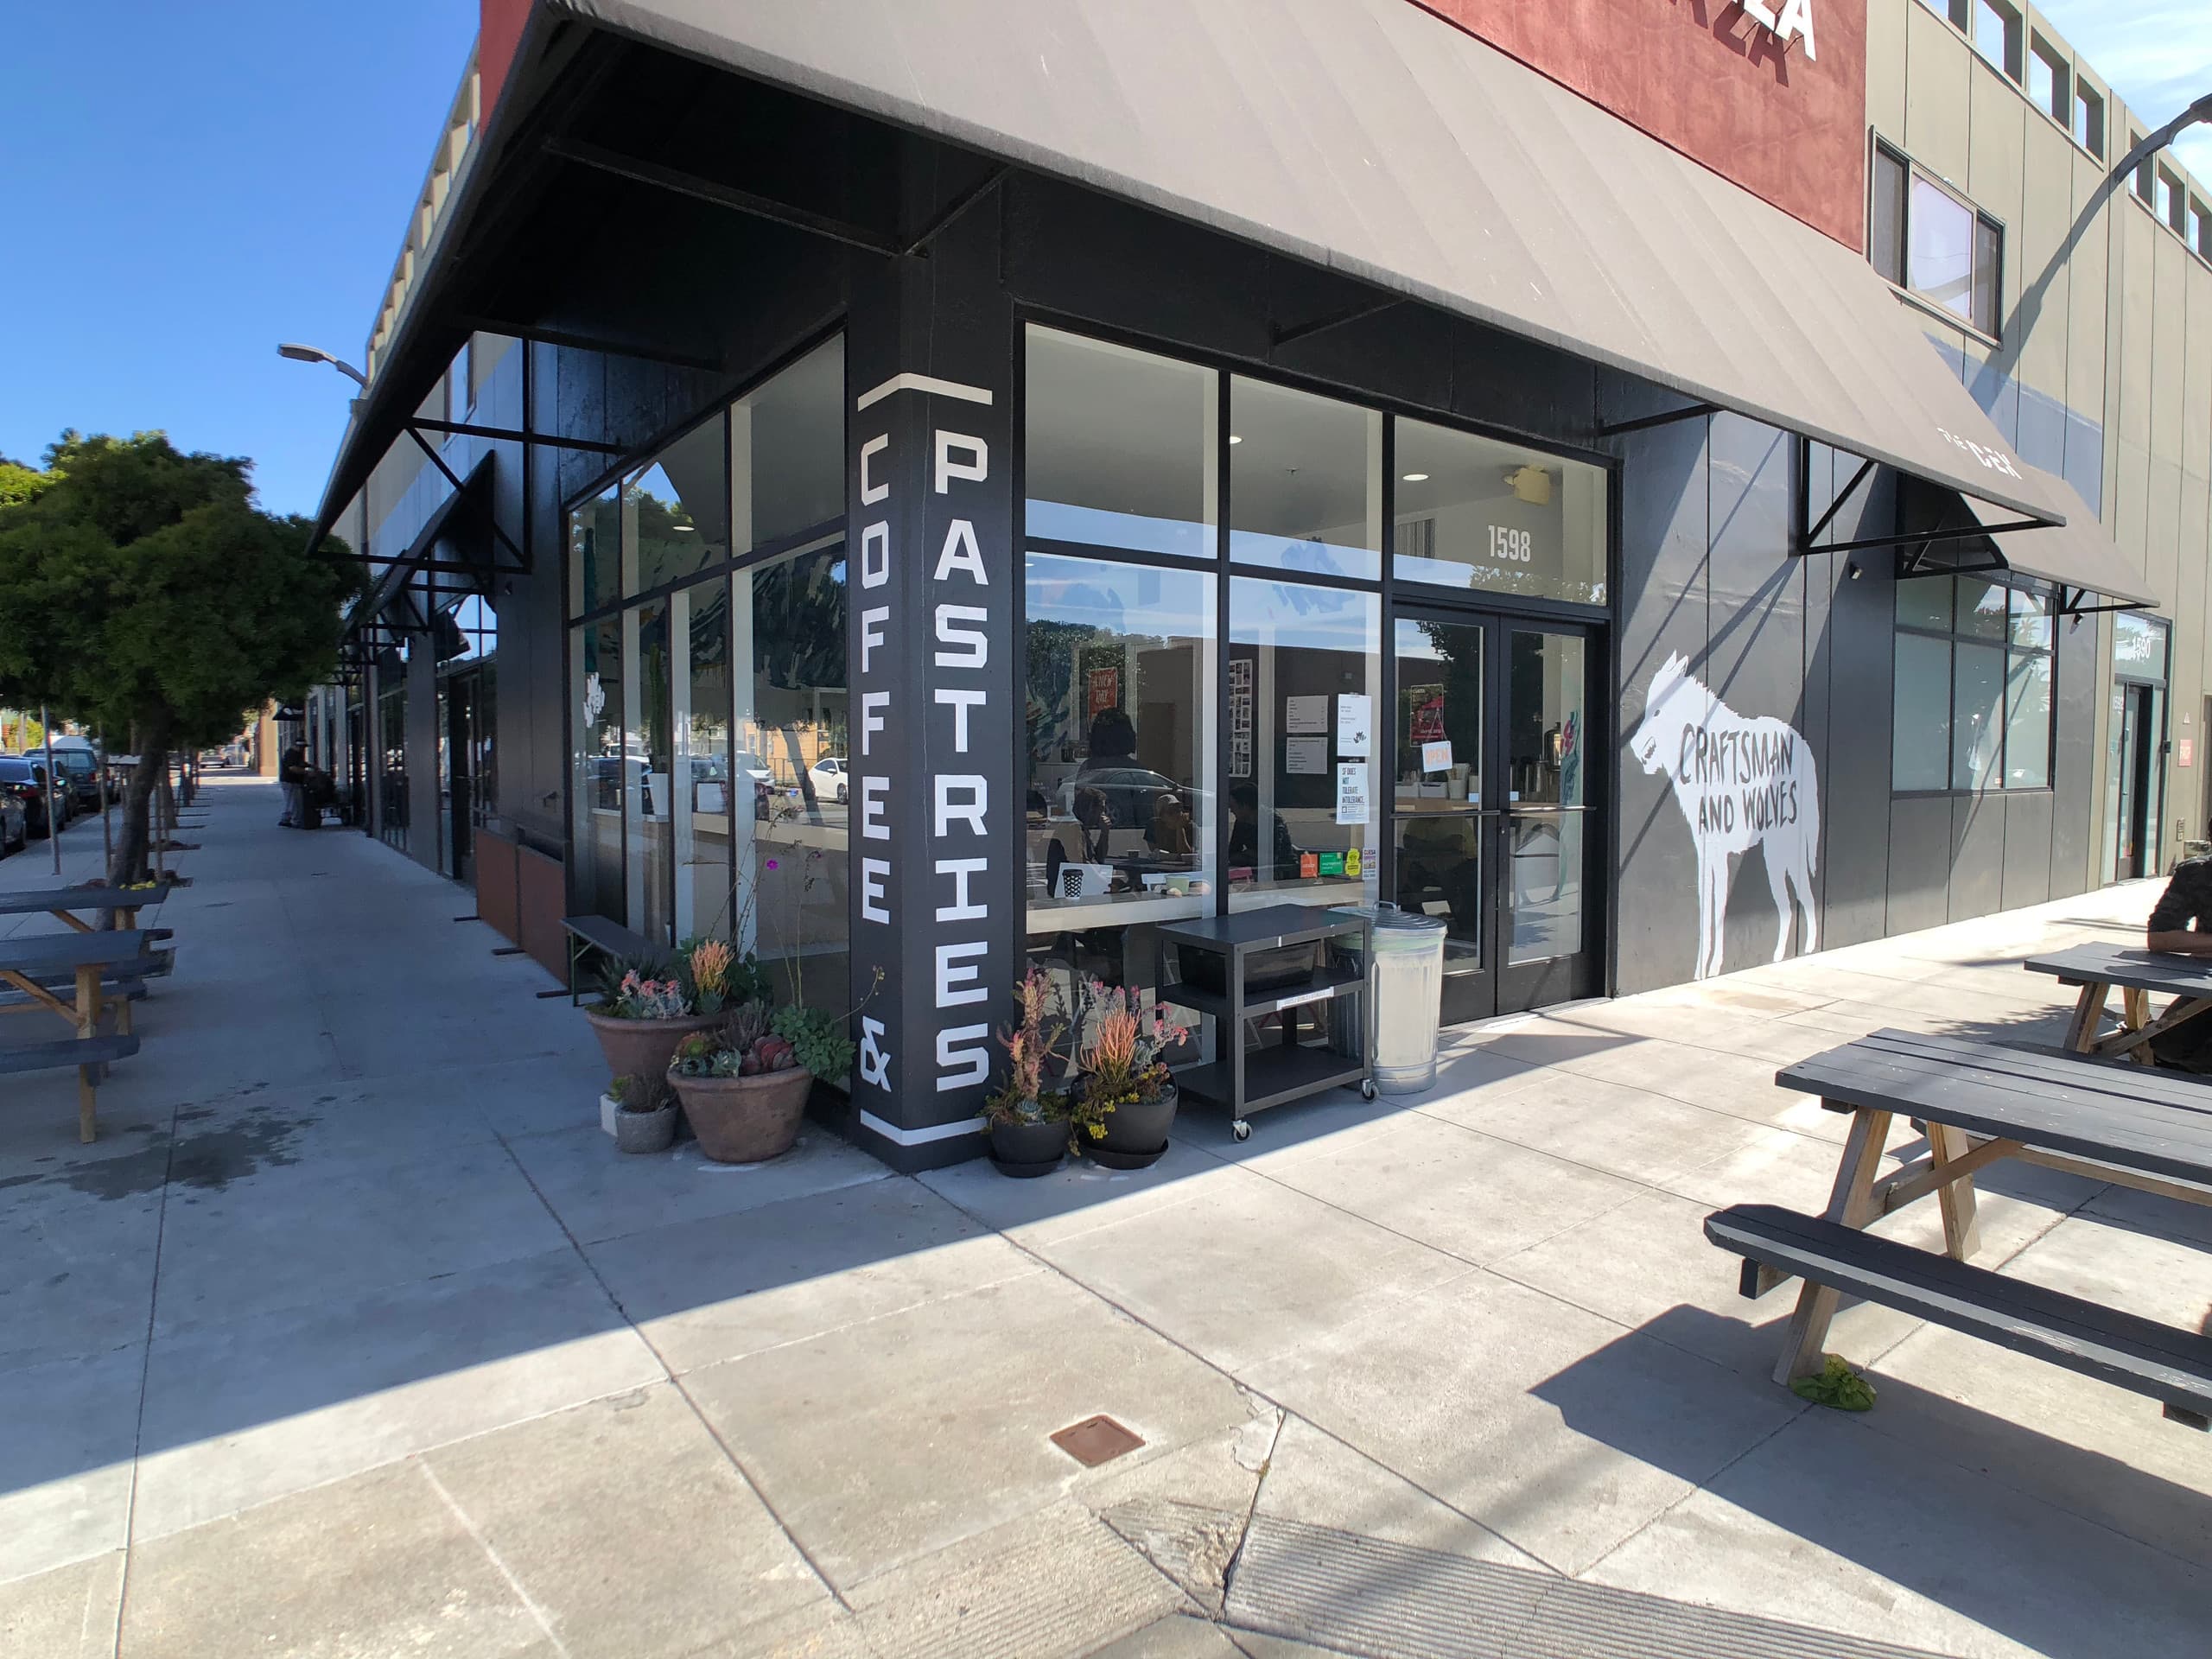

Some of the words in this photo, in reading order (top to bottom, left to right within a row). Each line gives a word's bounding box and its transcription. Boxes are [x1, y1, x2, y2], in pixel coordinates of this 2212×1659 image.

[1488, 524, 1531, 563] 1598
[861, 433, 890, 925] COFFEE
[933, 429, 989, 1092] PASTRIES
[1425, 747, 1450, 766] OPEN
[1680, 723, 1794, 785] CRAFTSMAN
[1698, 795, 1734, 836] AND
[1742, 780, 1797, 831] WOLVES
[861, 1016, 892, 1092] &
